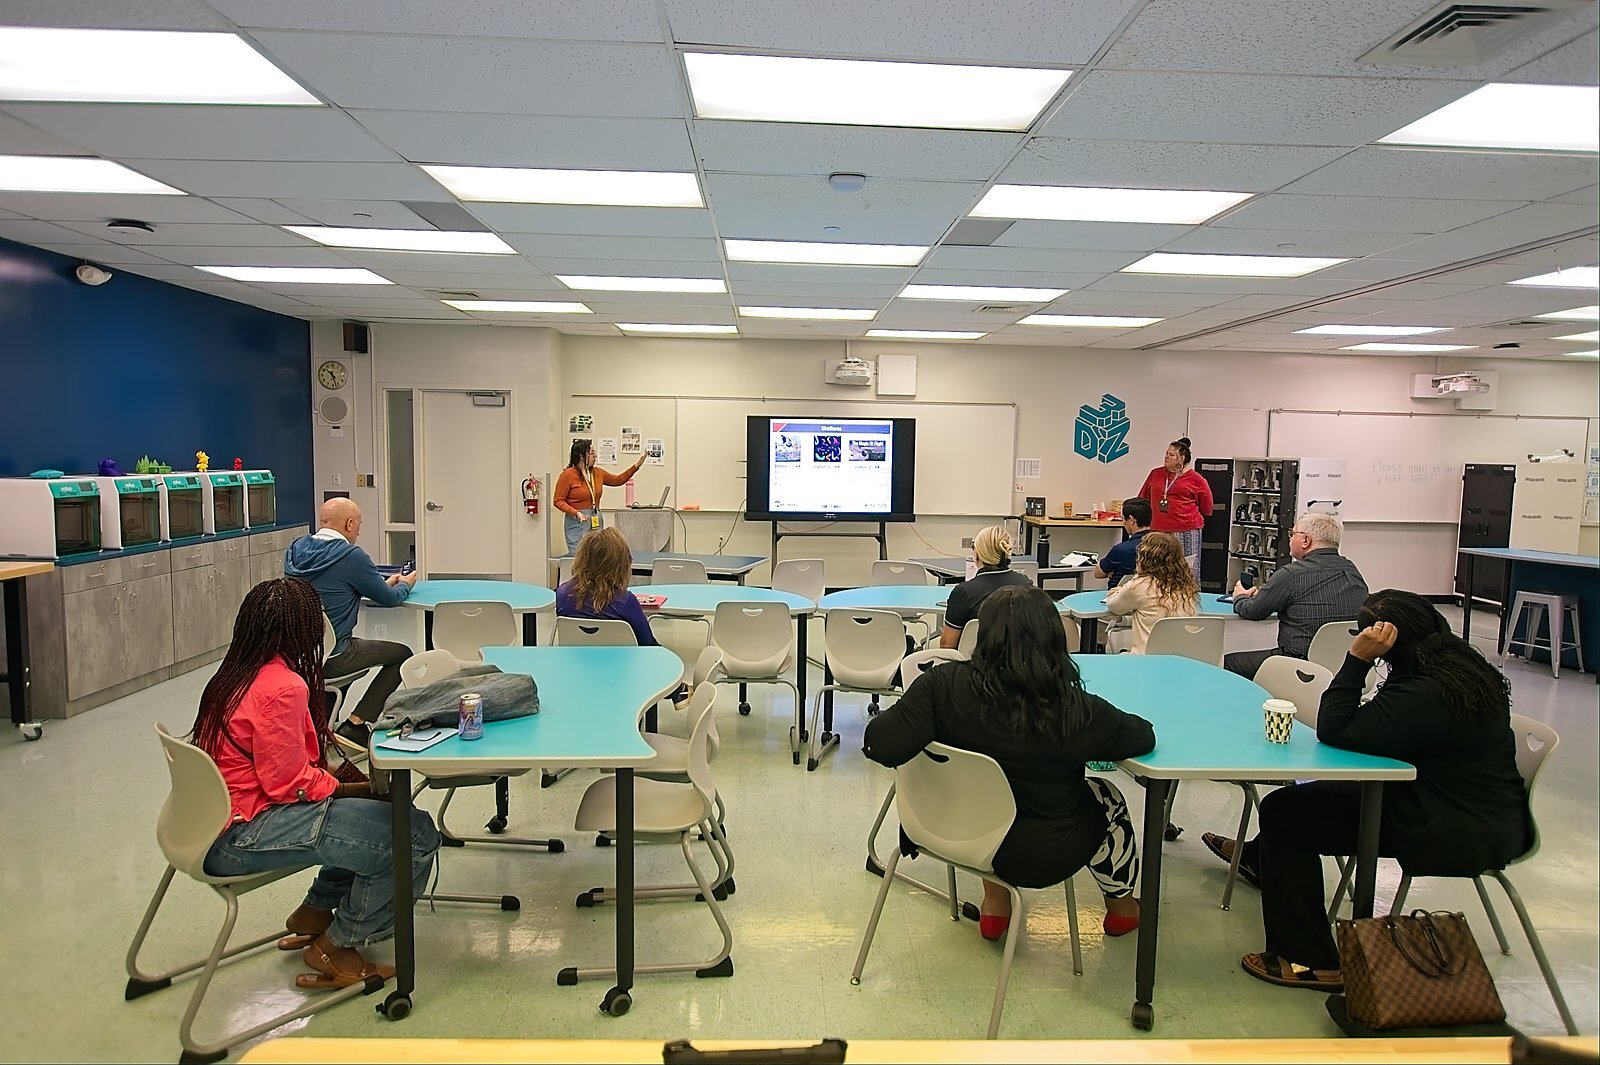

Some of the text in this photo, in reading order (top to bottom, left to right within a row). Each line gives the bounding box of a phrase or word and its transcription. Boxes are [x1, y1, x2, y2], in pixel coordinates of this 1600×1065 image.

[1372, 458, 1402, 472] Please
[1408, 464, 1427, 473] sign
[1432, 464, 1440, 473] in
[1385, 474, 1405, 483] table
